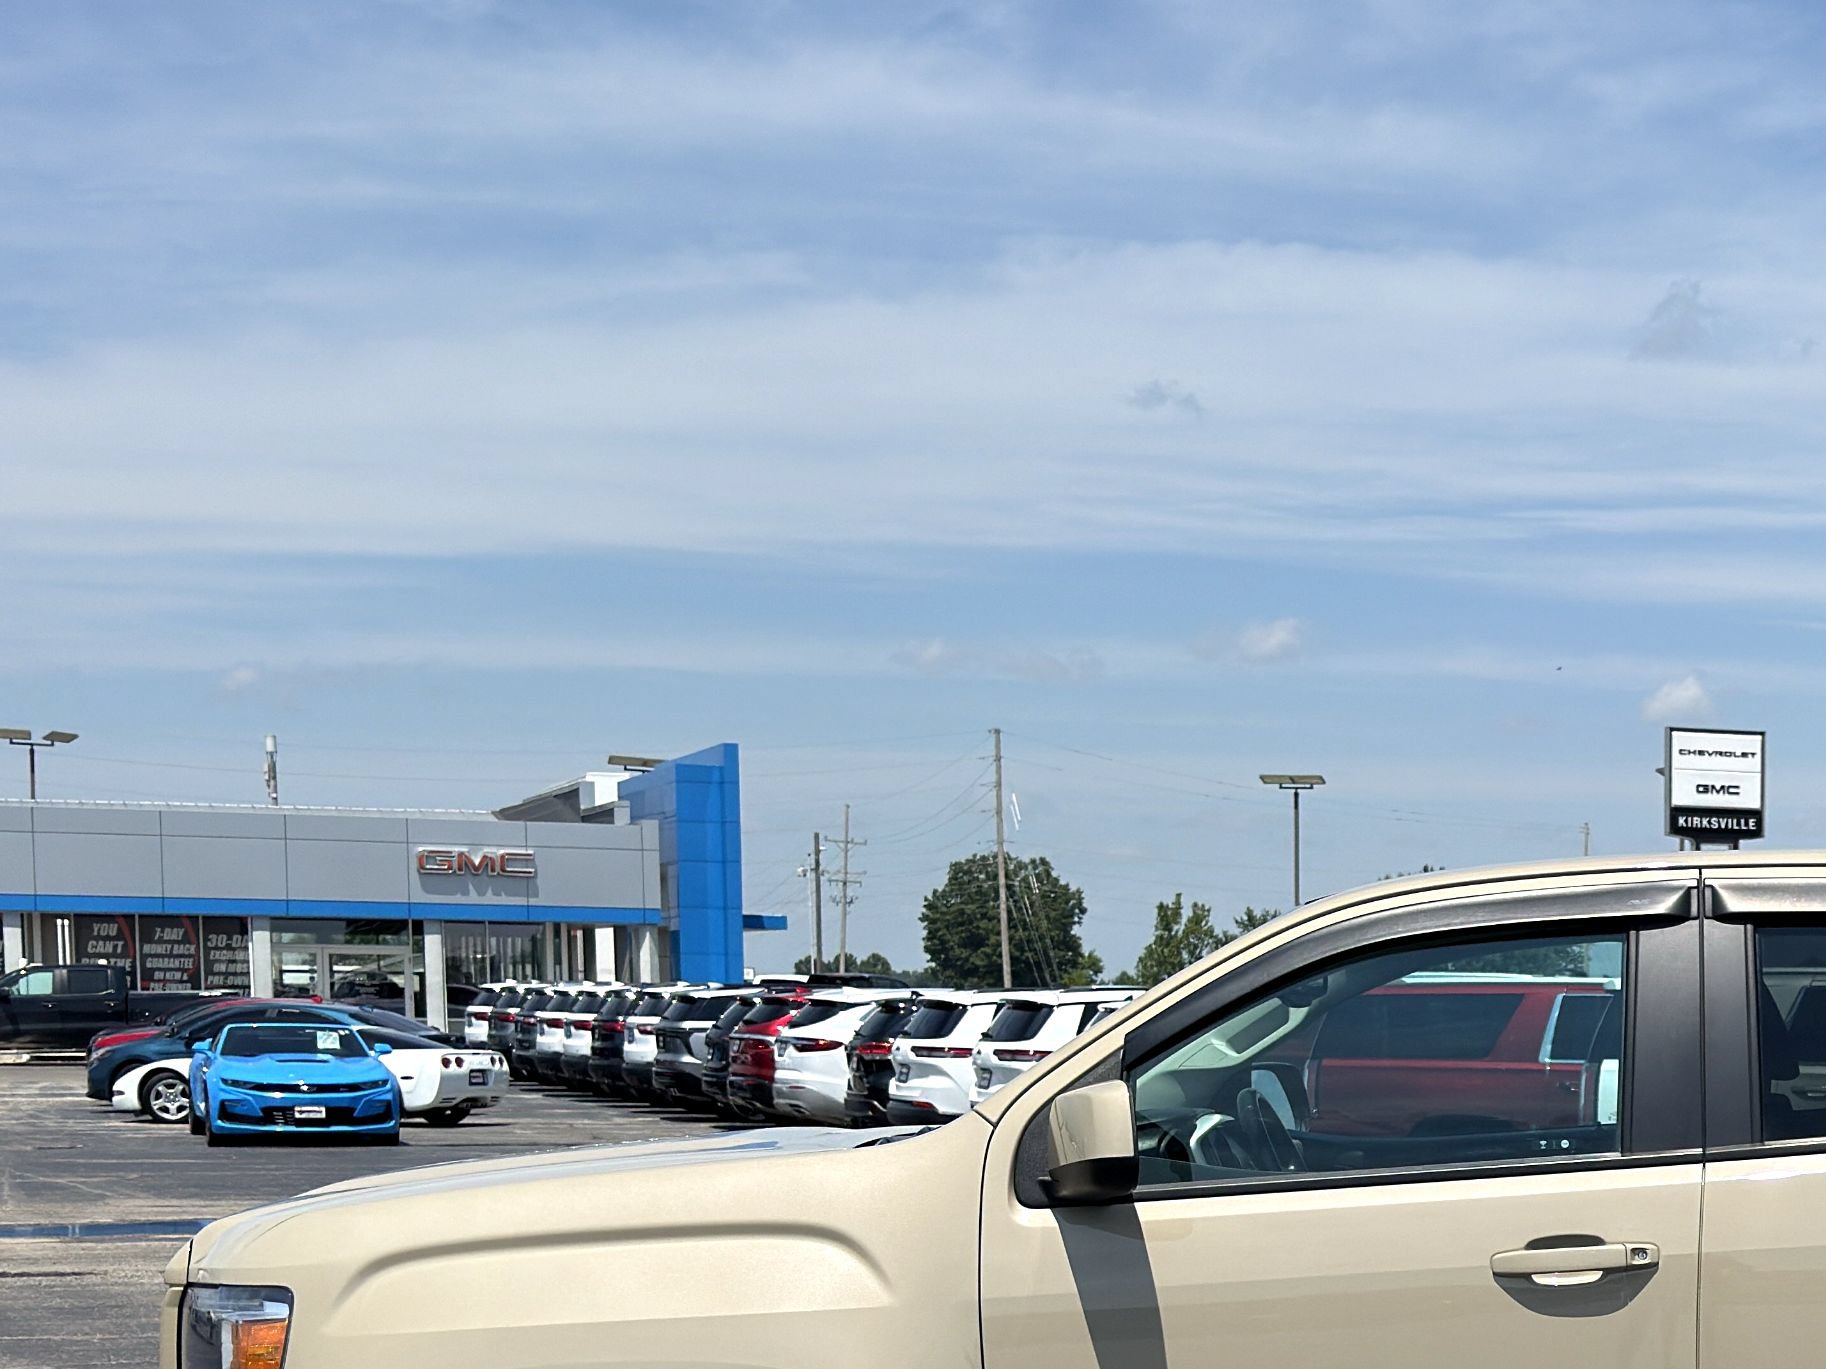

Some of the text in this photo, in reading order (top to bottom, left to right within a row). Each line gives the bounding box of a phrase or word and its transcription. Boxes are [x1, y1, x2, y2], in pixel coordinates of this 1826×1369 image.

[1678, 748, 1758, 759] CHEVROLET
[1695, 783, 1741, 796] GMC
[1677, 815, 1758, 831] KIRKSVILLE
[417, 846, 535, 877] GMC
[92, 923, 119, 936] YOU
[154, 927, 185, 940] 7-DAY
[87, 940, 125, 954] CAN'T
[207, 934, 249, 948] 30-DA
[142, 943, 197, 955] MONEY BACK
[145, 957, 194, 969] GUARANTEE
[227, 963, 249, 973] MOS
[207, 975, 250, 986] PRE-OWN
